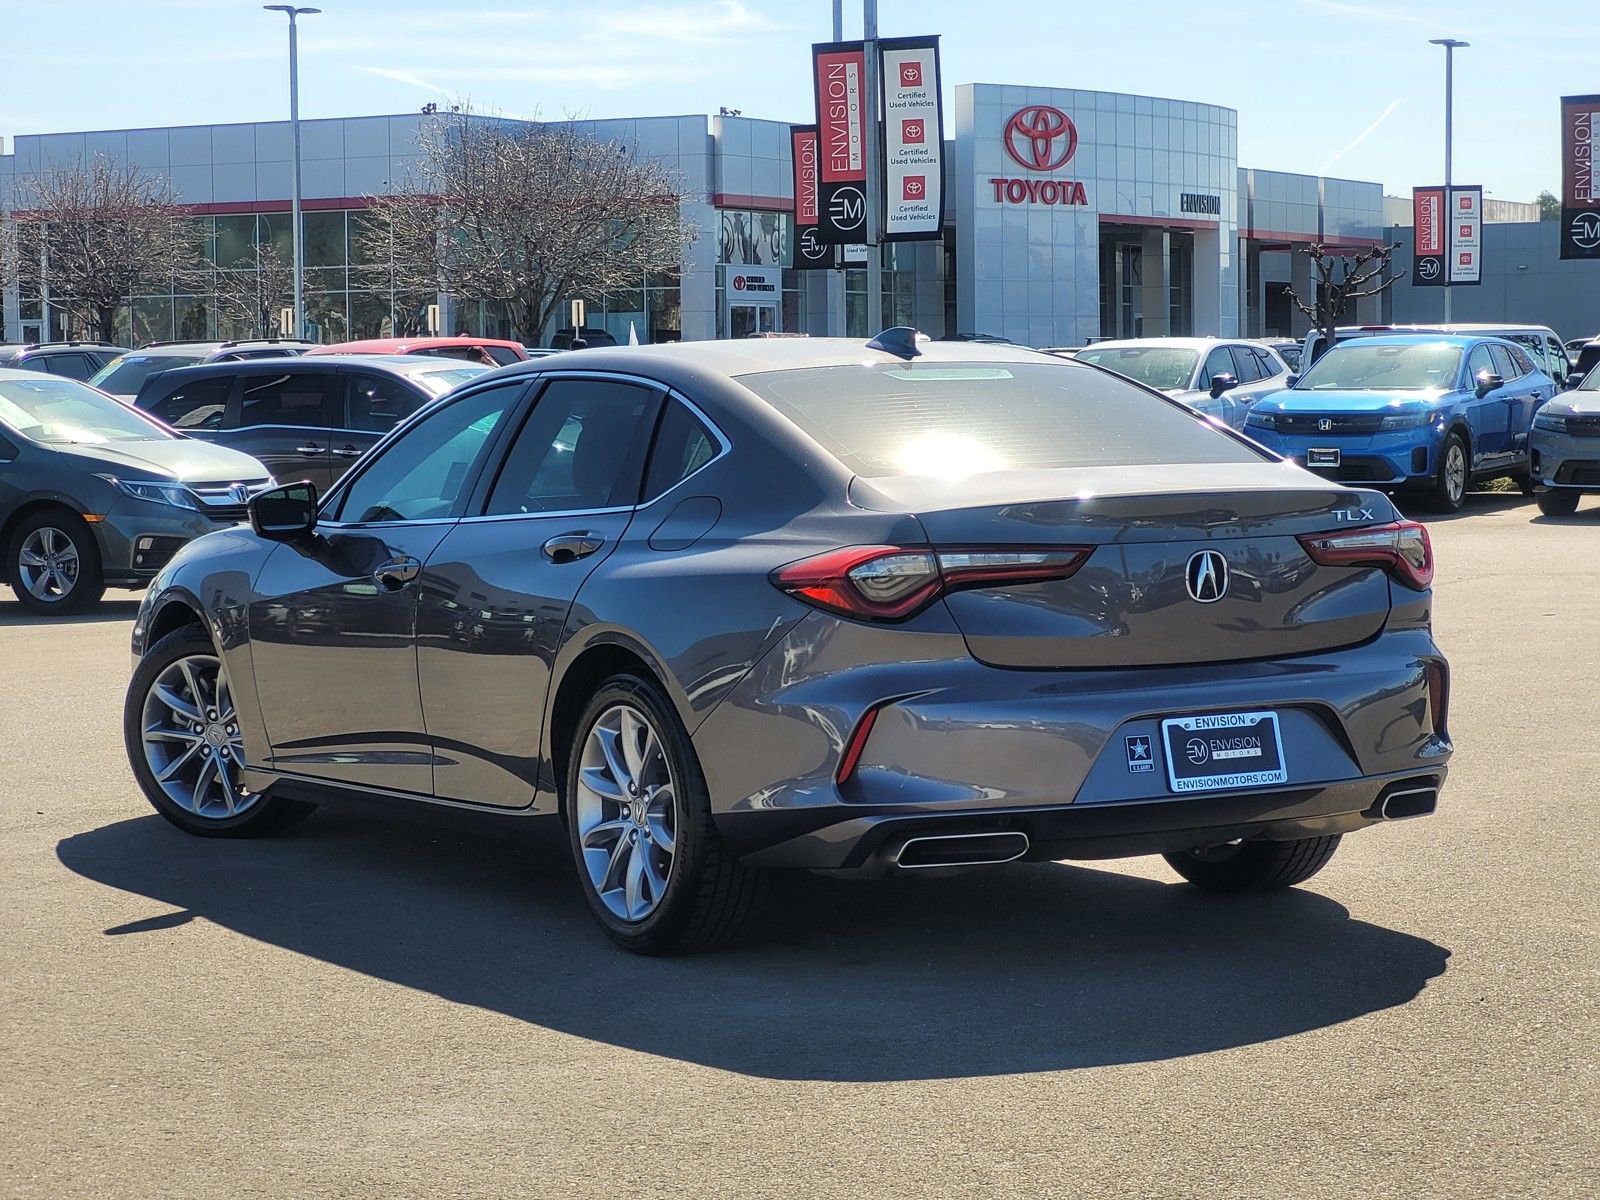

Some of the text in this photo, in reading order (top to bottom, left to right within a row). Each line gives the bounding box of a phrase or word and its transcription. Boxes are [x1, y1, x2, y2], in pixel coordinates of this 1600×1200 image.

[897, 91, 926, 99] Certified
[827, 63, 848, 172] ENVISION
[848, 72, 859, 161] MOTORS
[899, 148, 928, 156] Certified
[909, 156, 937, 164] Vehicles
[1574, 112, 1590, 200] ENVISION
[801, 139, 815, 217] ENVISION
[988, 178, 1088, 206] TOYOTA
[1180, 193, 1220, 215] ENVISION
[1420, 196, 1431, 251] ENVISION
[1331, 508, 1374, 522] TLX
[1195, 715, 1246, 729] ENVISION
[1210, 736, 1261, 751] ENVISION
[1216, 750, 1259, 758] MOTORS
[1177, 773, 1282, 790] ENVISIONMOTORS.COM
